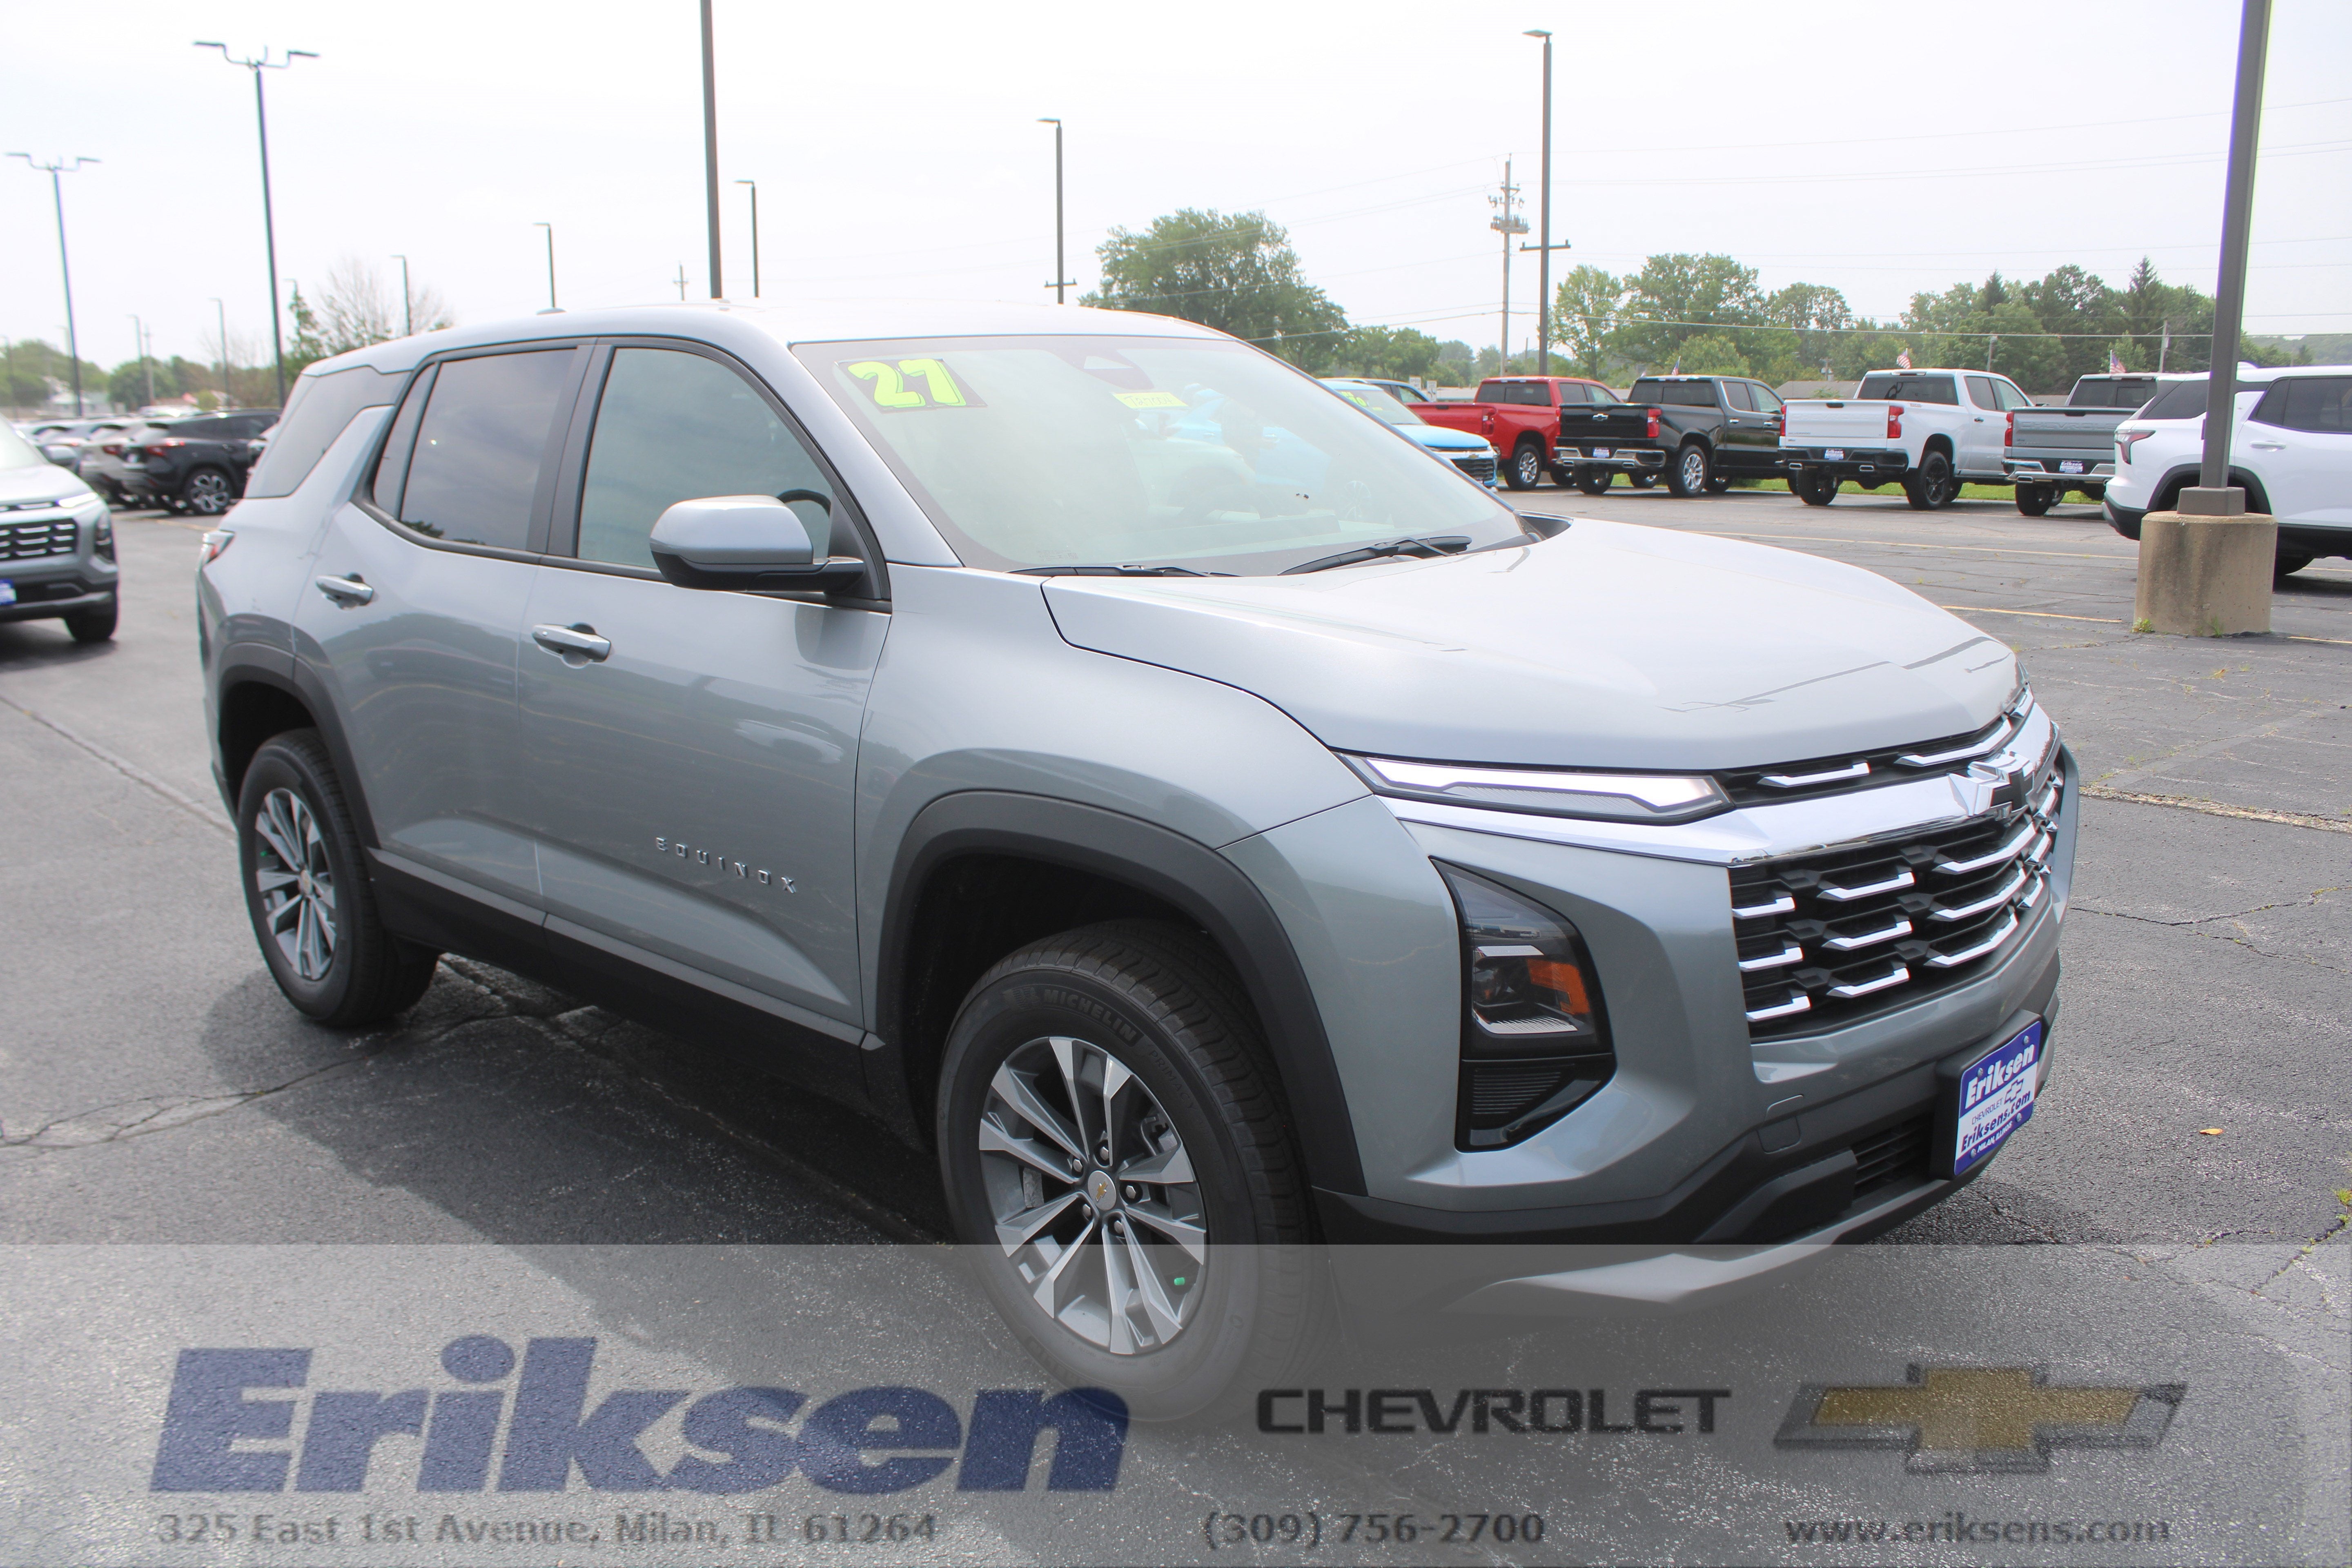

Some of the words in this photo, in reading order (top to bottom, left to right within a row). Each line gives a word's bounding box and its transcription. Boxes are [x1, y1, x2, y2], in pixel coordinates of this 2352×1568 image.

[847, 359, 967, 408] 27
[656, 837, 797, 894] EQUINOX
[1044, 989, 1137, 1042] MICHELIN
[1148, 1049, 1198, 1111] PRIMACY
[1964, 1044, 2035, 1109] Eriksen
[1960, 1090, 2031, 1153] Eriksens.com
[1971, 1098, 2003, 1125] CHEVROLET
[1995, 1120, 2013, 1141] ILLINOIS
